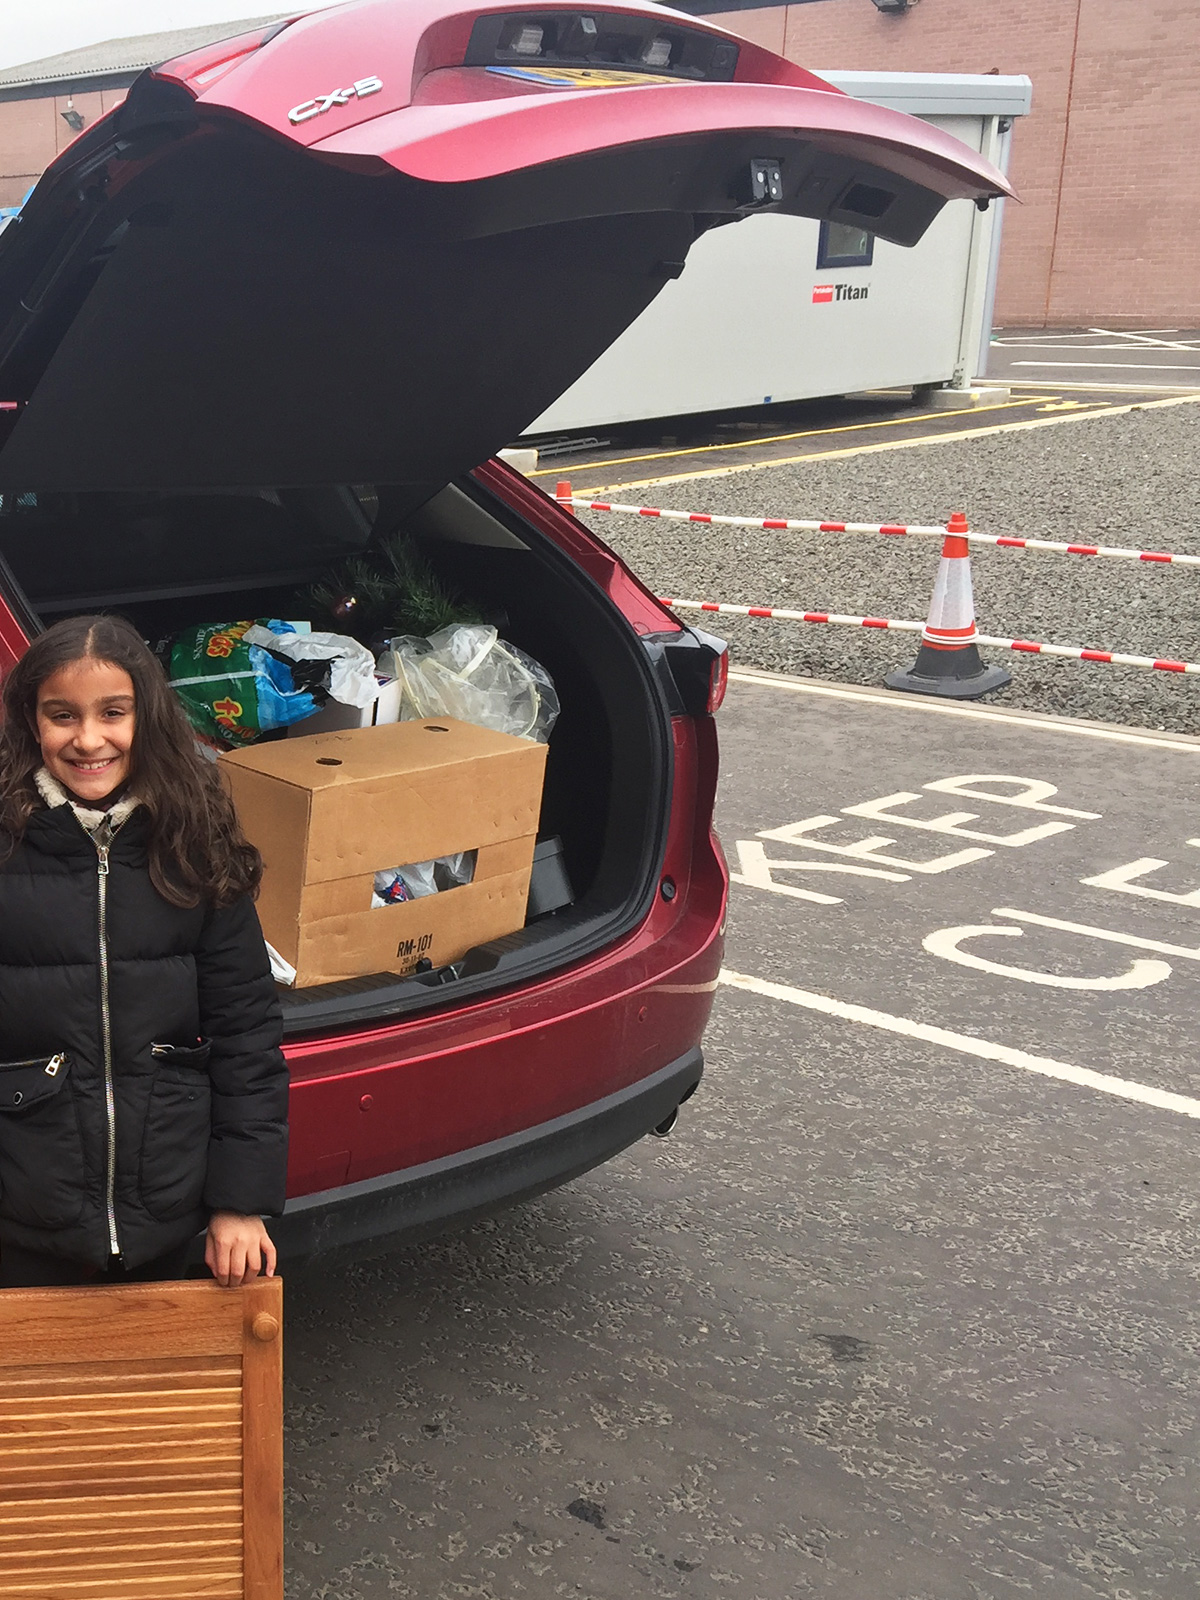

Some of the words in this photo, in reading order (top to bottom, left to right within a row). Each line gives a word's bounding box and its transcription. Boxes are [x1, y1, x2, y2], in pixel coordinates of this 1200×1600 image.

[287, 75, 384, 126] CX-5
[835, 284, 868, 301] Titan
[730, 774, 1102, 904] KEEP
[397, 933, 433, 958] RM-101
